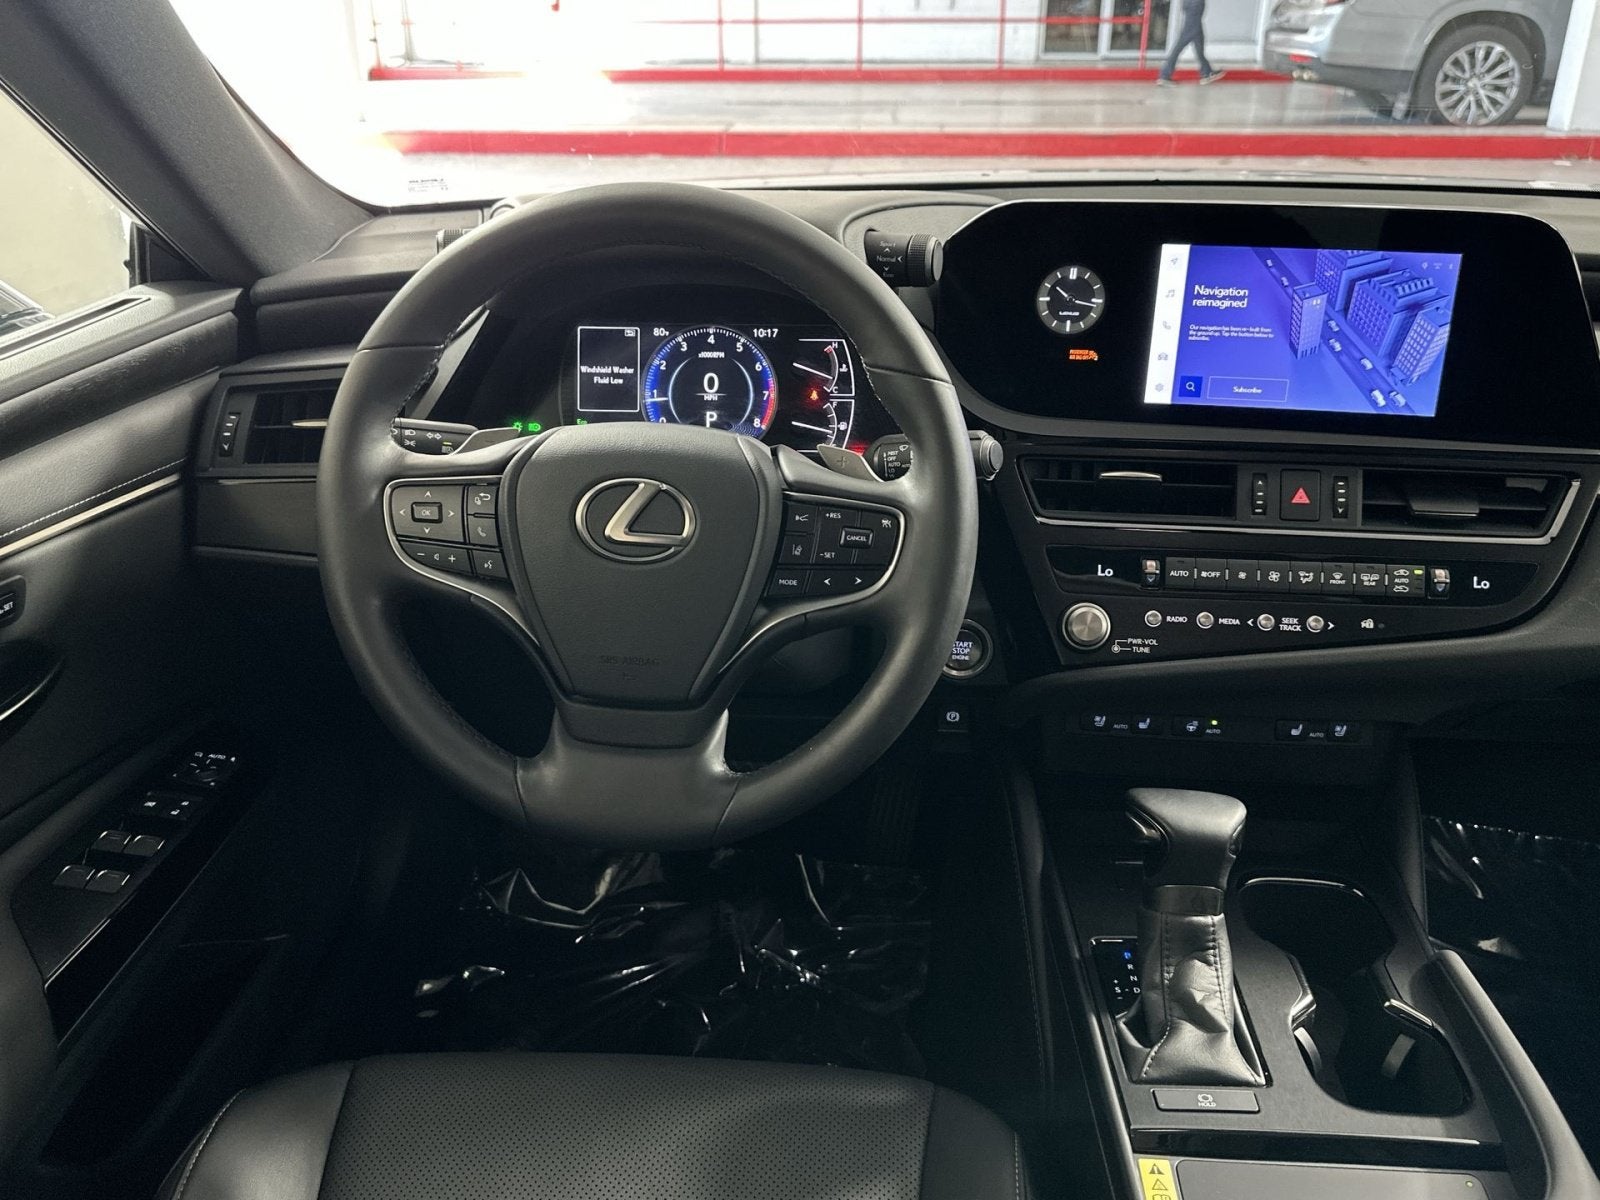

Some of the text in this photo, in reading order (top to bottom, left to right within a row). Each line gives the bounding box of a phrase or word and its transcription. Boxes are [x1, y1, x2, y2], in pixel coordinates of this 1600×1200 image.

[1194, 284, 1249, 298] Navigation
[1192, 298, 1248, 309] reimagined
[753, 328, 779, 338] 10:17
[707, 334, 715, 344] 4
[680, 342, 688, 352] 3
[736, 342, 744, 352] 5
[659, 360, 666, 370] 2
[755, 361, 762, 372] 6
[593, 376, 610, 384] Fluid
[703, 372, 719, 394] 0
[652, 389, 658, 398] 1
[1232, 385, 1262, 394] Subscribe
[762, 391, 769, 400] 7
[706, 411, 718, 428] P
[753, 418, 761, 428] 8
[1097, 564, 1114, 577] Lo
[1473, 576, 1490, 590] Lo
